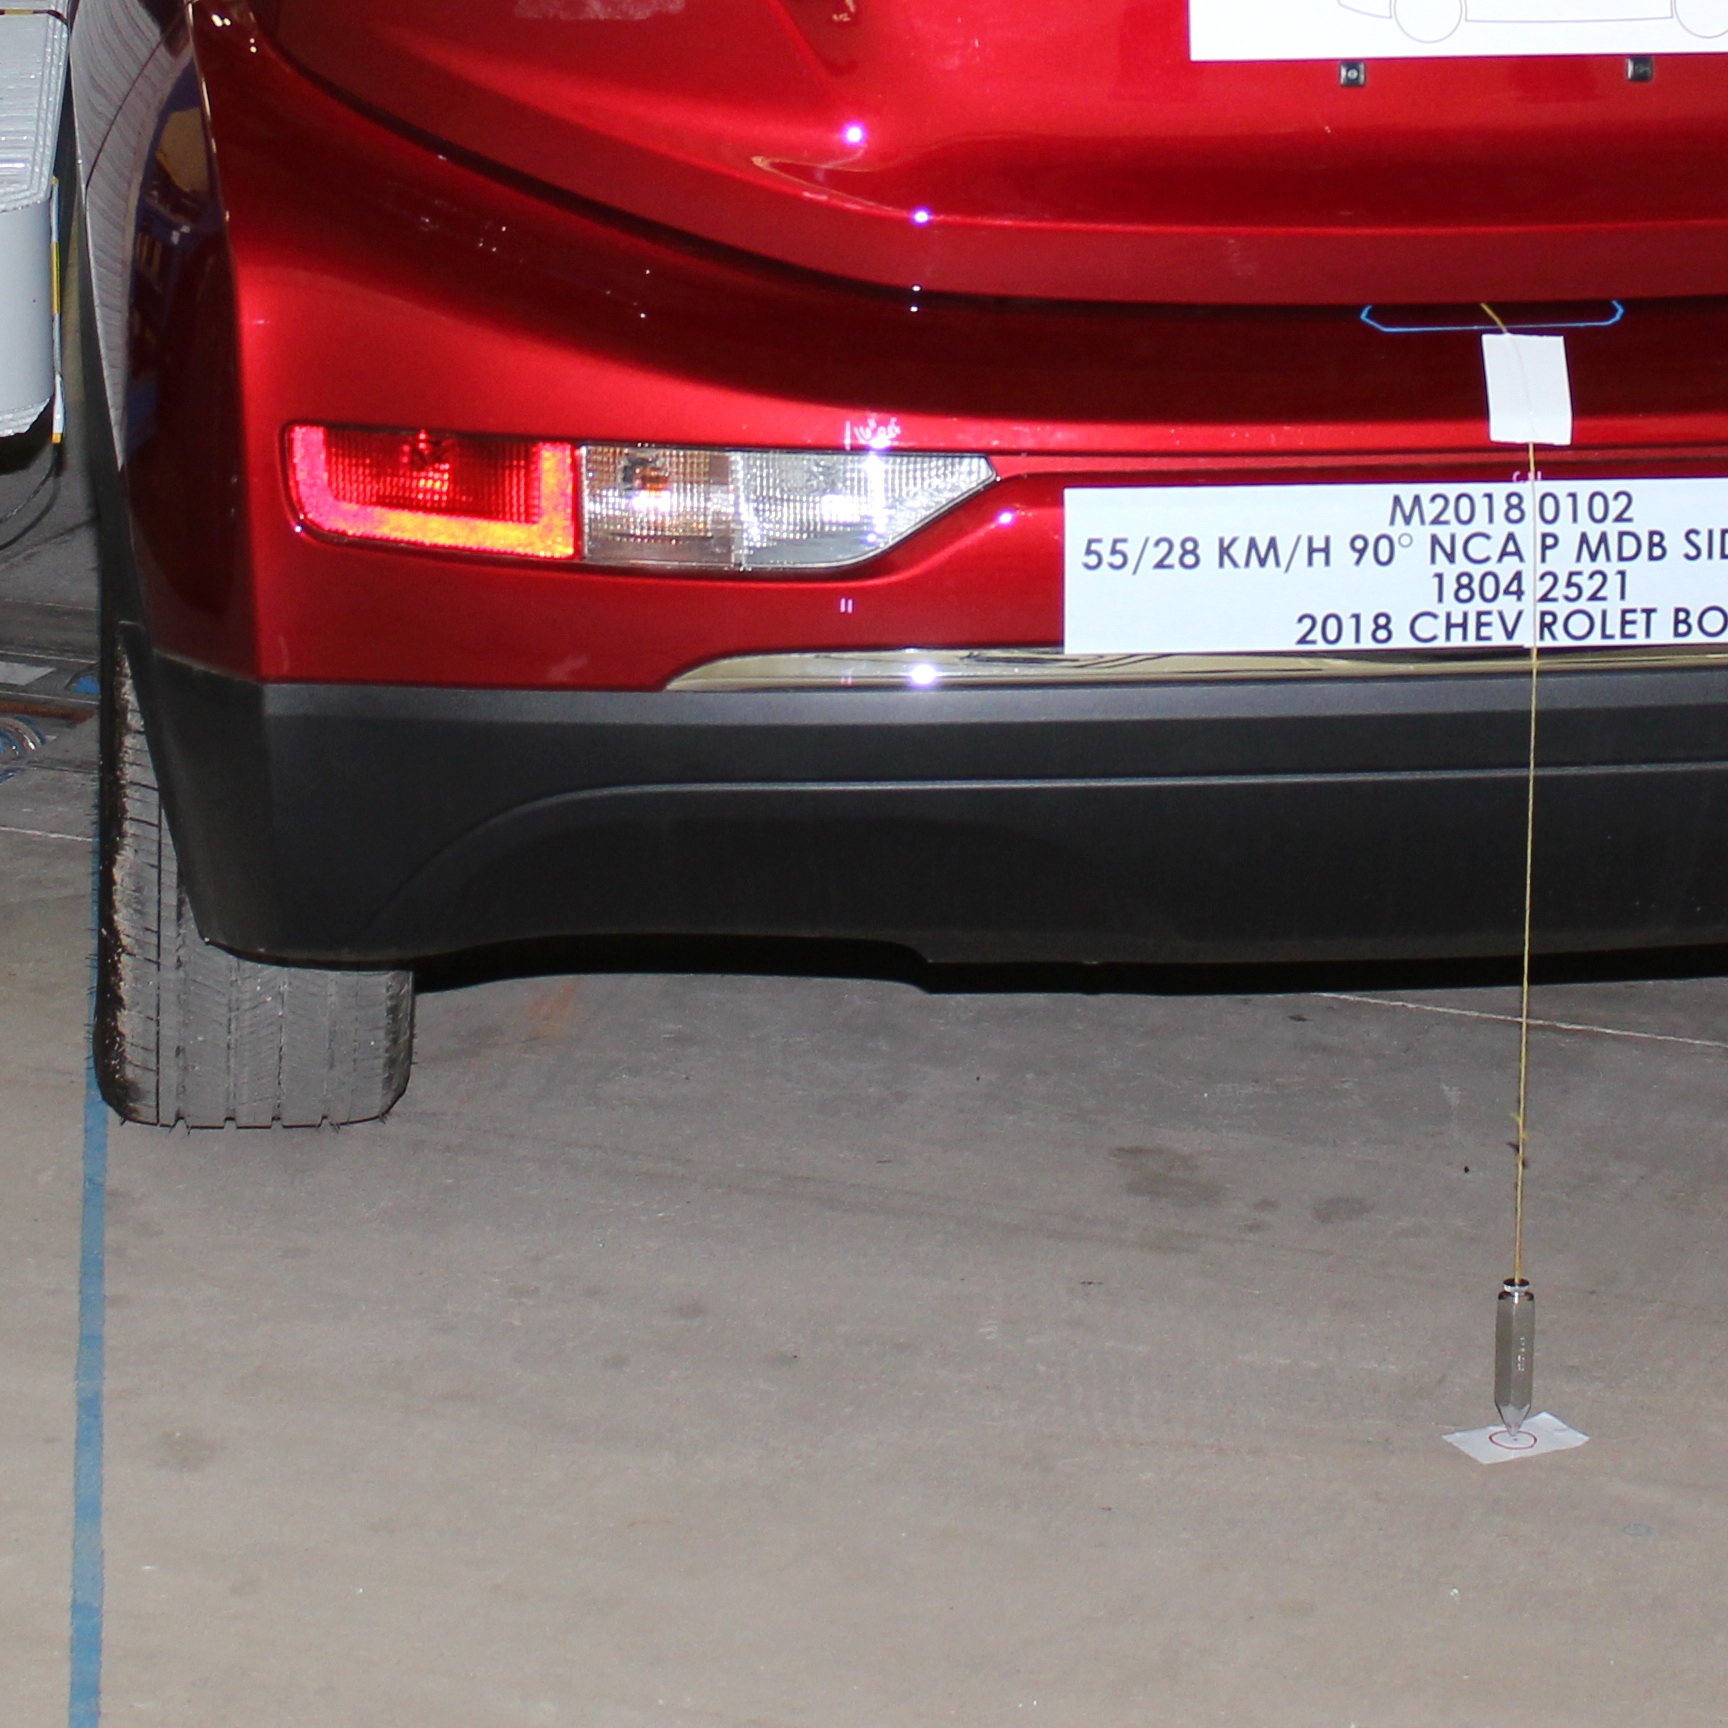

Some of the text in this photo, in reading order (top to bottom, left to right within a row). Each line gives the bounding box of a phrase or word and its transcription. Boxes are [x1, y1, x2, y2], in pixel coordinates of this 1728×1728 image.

[1388, 490, 1635, 526] M20180102
[1081, 535, 1202, 576] 55/28
[1218, 533, 1332, 574] KM/H
[1348, 532, 1414, 567] 90°
[1429, 530, 1560, 565] NCAP
[1575, 529, 1668, 564] MDB
[1431, 569, 1628, 604] 18042521
[1295, 612, 1393, 646] 2018
[1408, 607, 1659, 643] CHEVROLET
